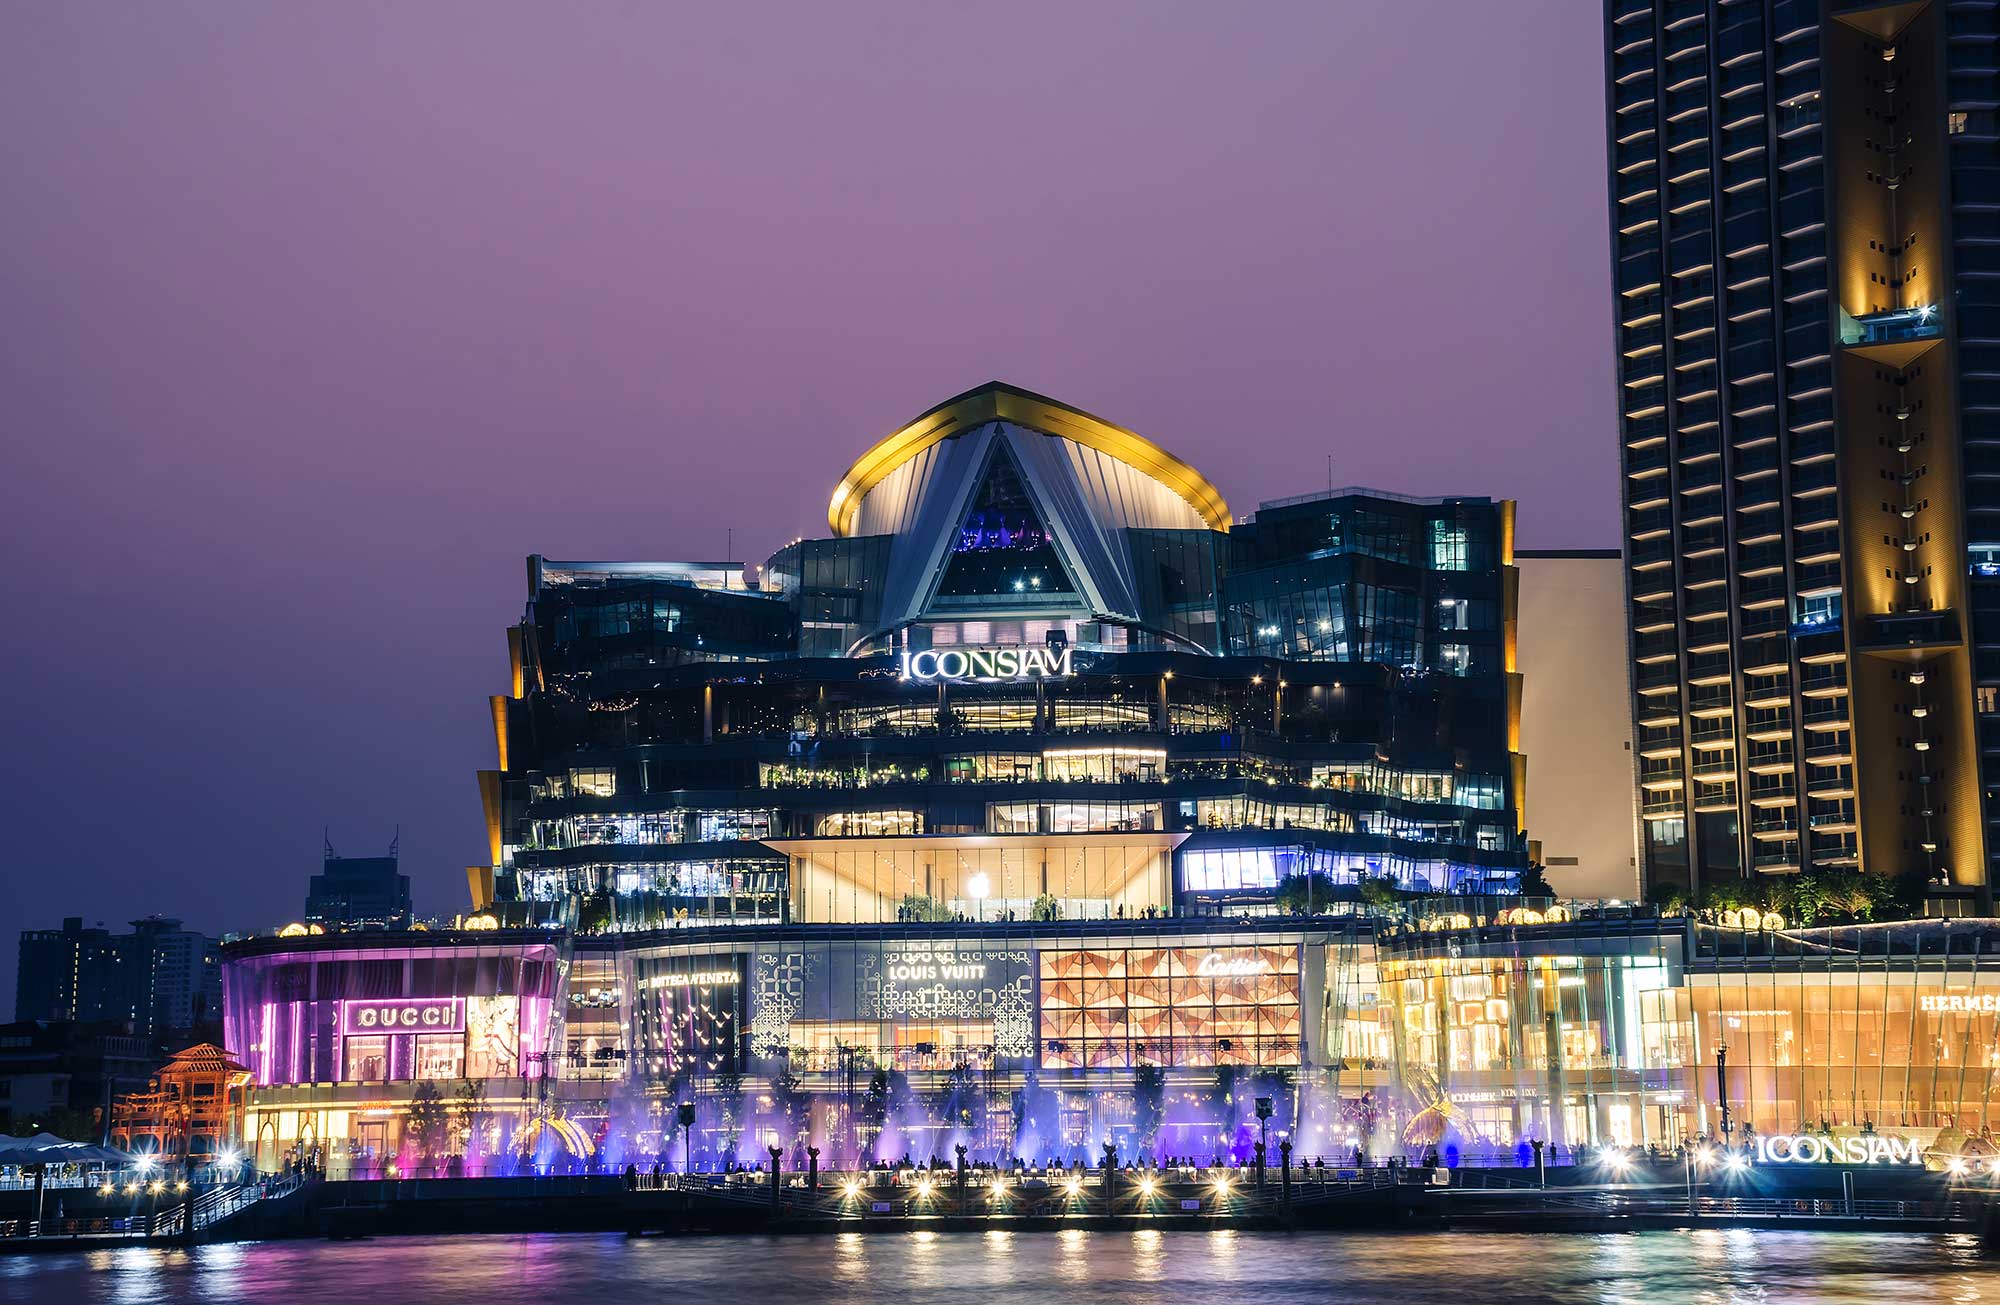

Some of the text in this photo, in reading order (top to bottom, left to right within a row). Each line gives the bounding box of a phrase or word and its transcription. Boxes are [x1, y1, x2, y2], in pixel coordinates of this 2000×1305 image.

[900, 648, 1073, 679] ICONSIAM
[889, 965, 937, 980] LOUIS
[359, 1006, 450, 1026] GUCCI
[1756, 1136, 1922, 1164] ICONSIAM
